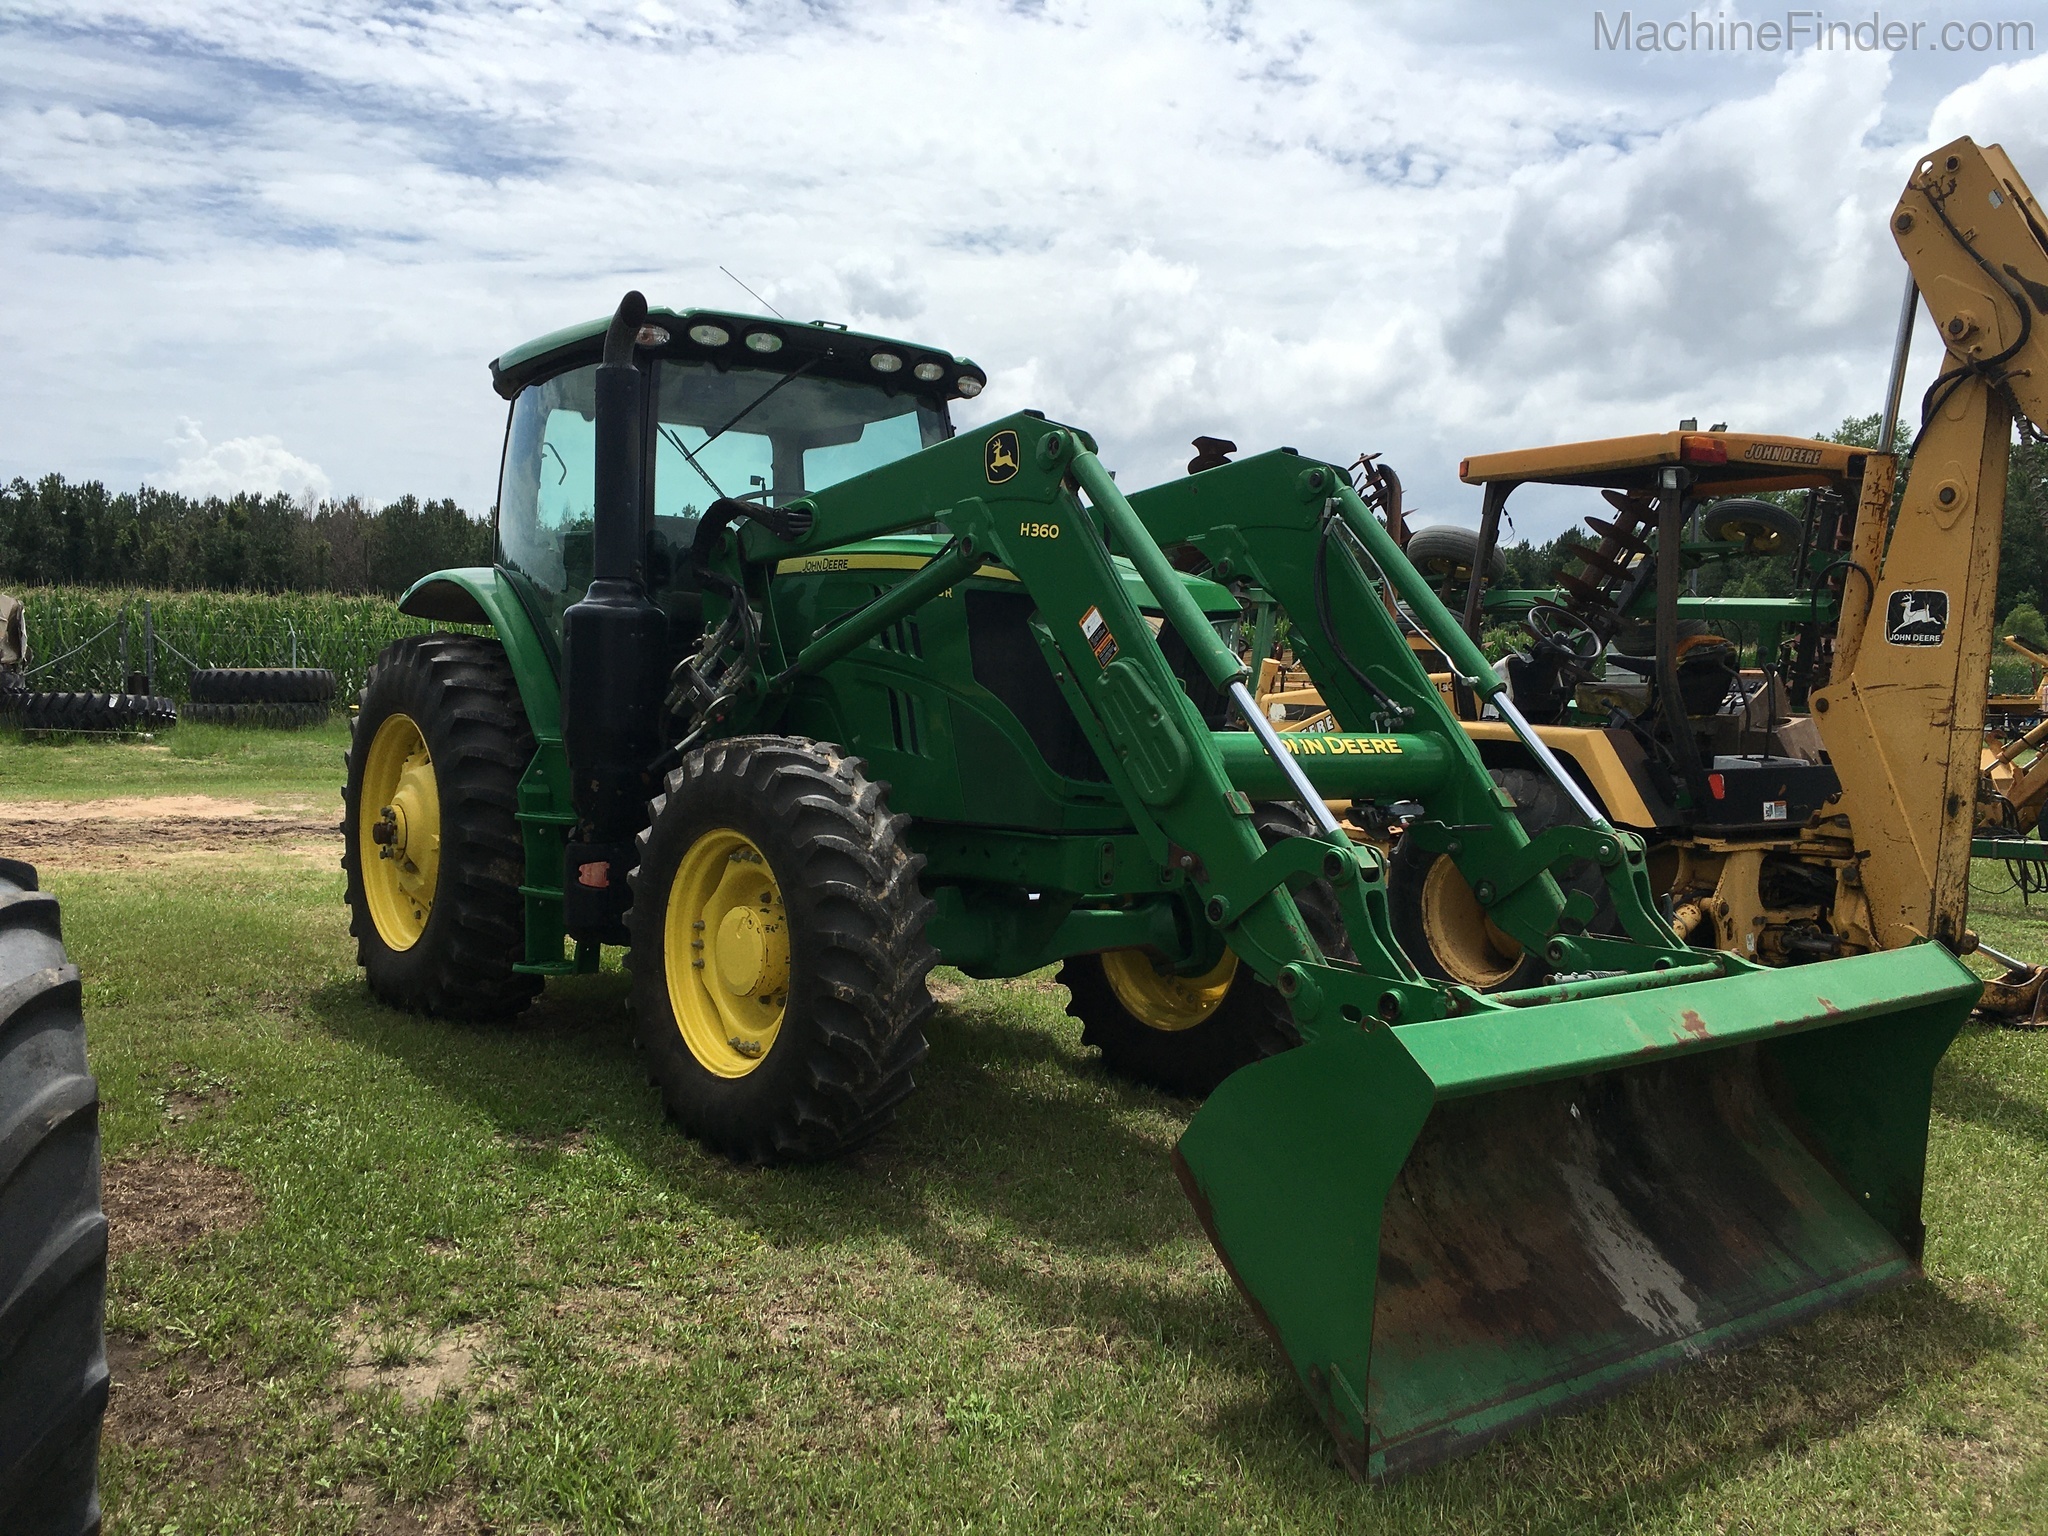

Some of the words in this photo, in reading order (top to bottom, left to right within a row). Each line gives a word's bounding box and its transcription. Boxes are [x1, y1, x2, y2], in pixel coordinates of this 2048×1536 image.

[1745, 443, 1781, 461] JOHN
[1782, 446, 1822, 465] DEERE
[1020, 522, 1060, 539] H360
[802, 559, 823, 572] JOHN
[823, 557, 849, 571] DEERE
[1890, 633, 1911, 641] JOHN
[1912, 633, 1941, 642] DEERE
[1323, 735, 1403, 754] DEERE
